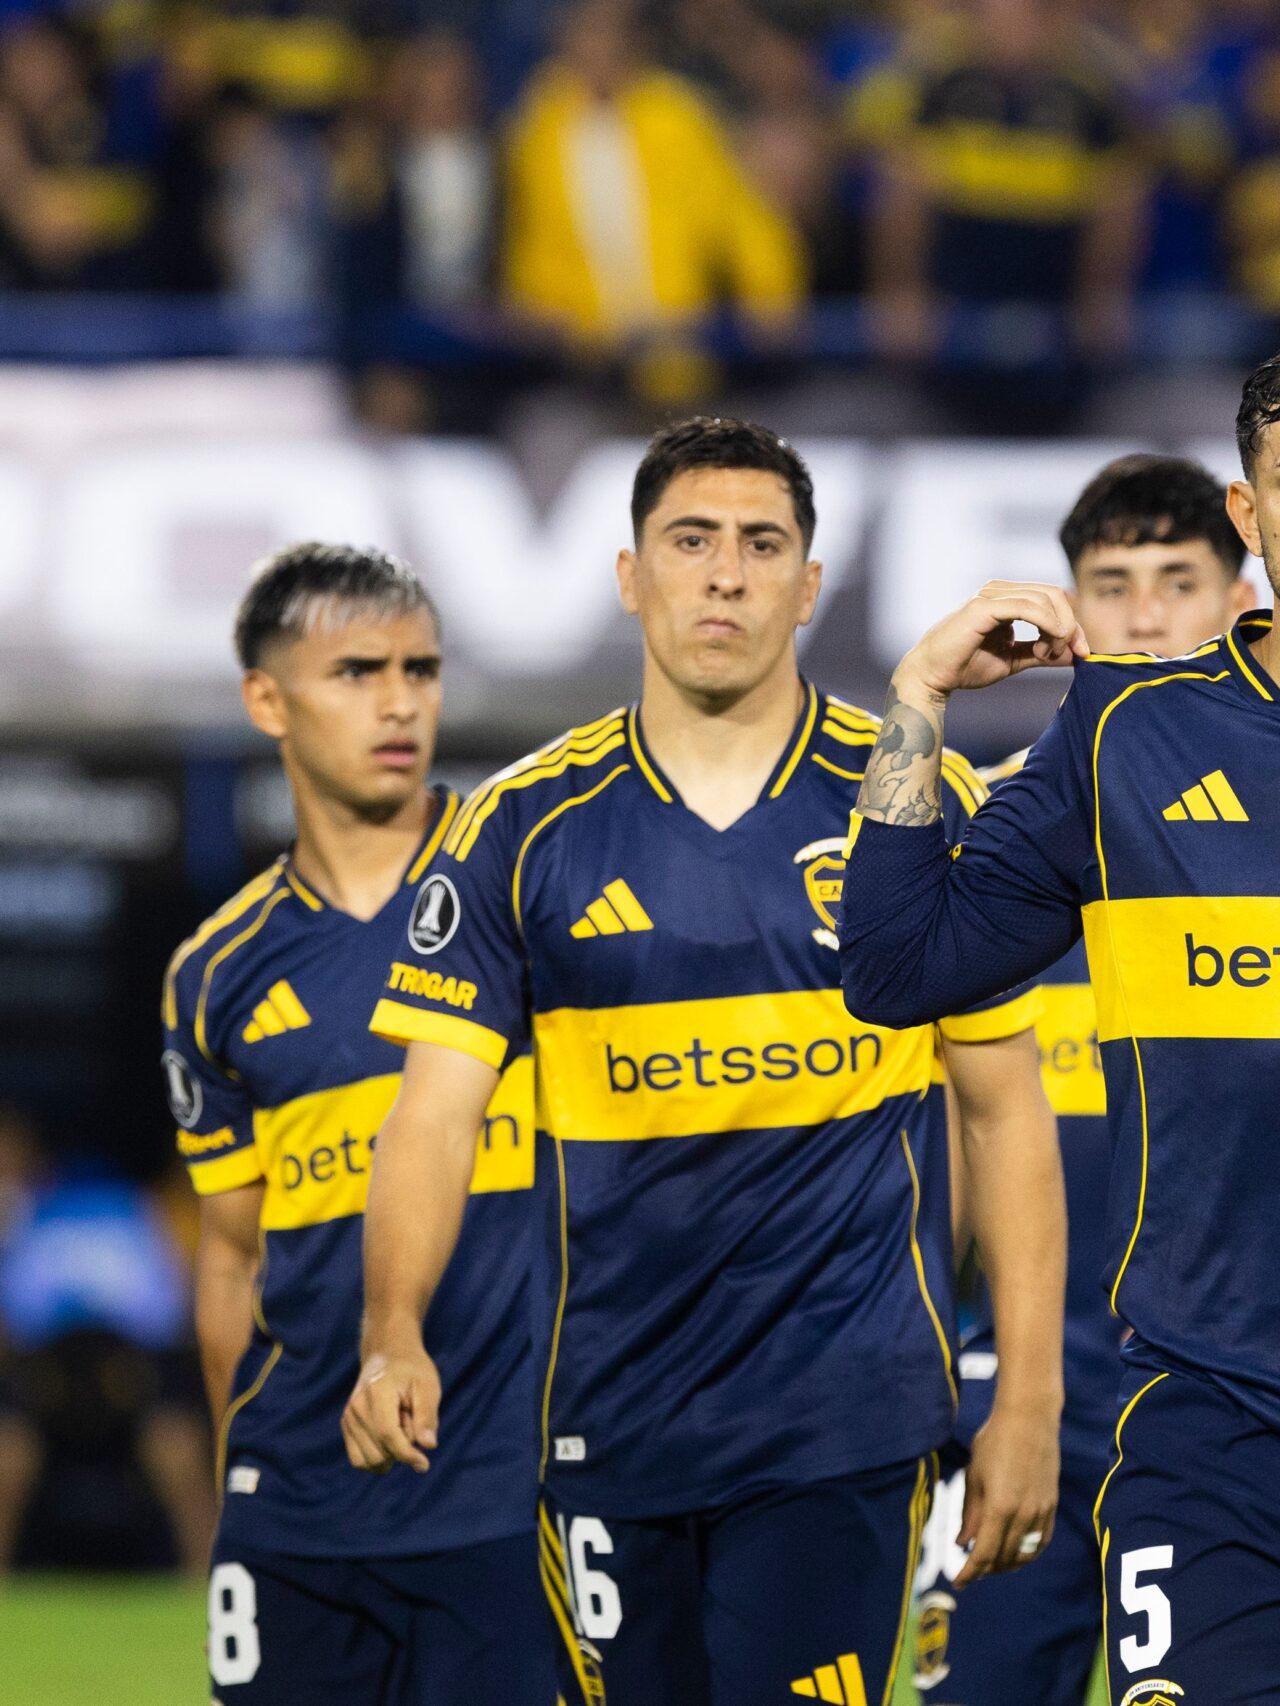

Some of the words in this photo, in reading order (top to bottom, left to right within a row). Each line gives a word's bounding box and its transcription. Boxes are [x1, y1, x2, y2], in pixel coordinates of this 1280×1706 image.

[819, 885, 842, 897] CA
[605, 1032, 882, 1093] betsson
[1119, 1544, 1174, 1674] 5
